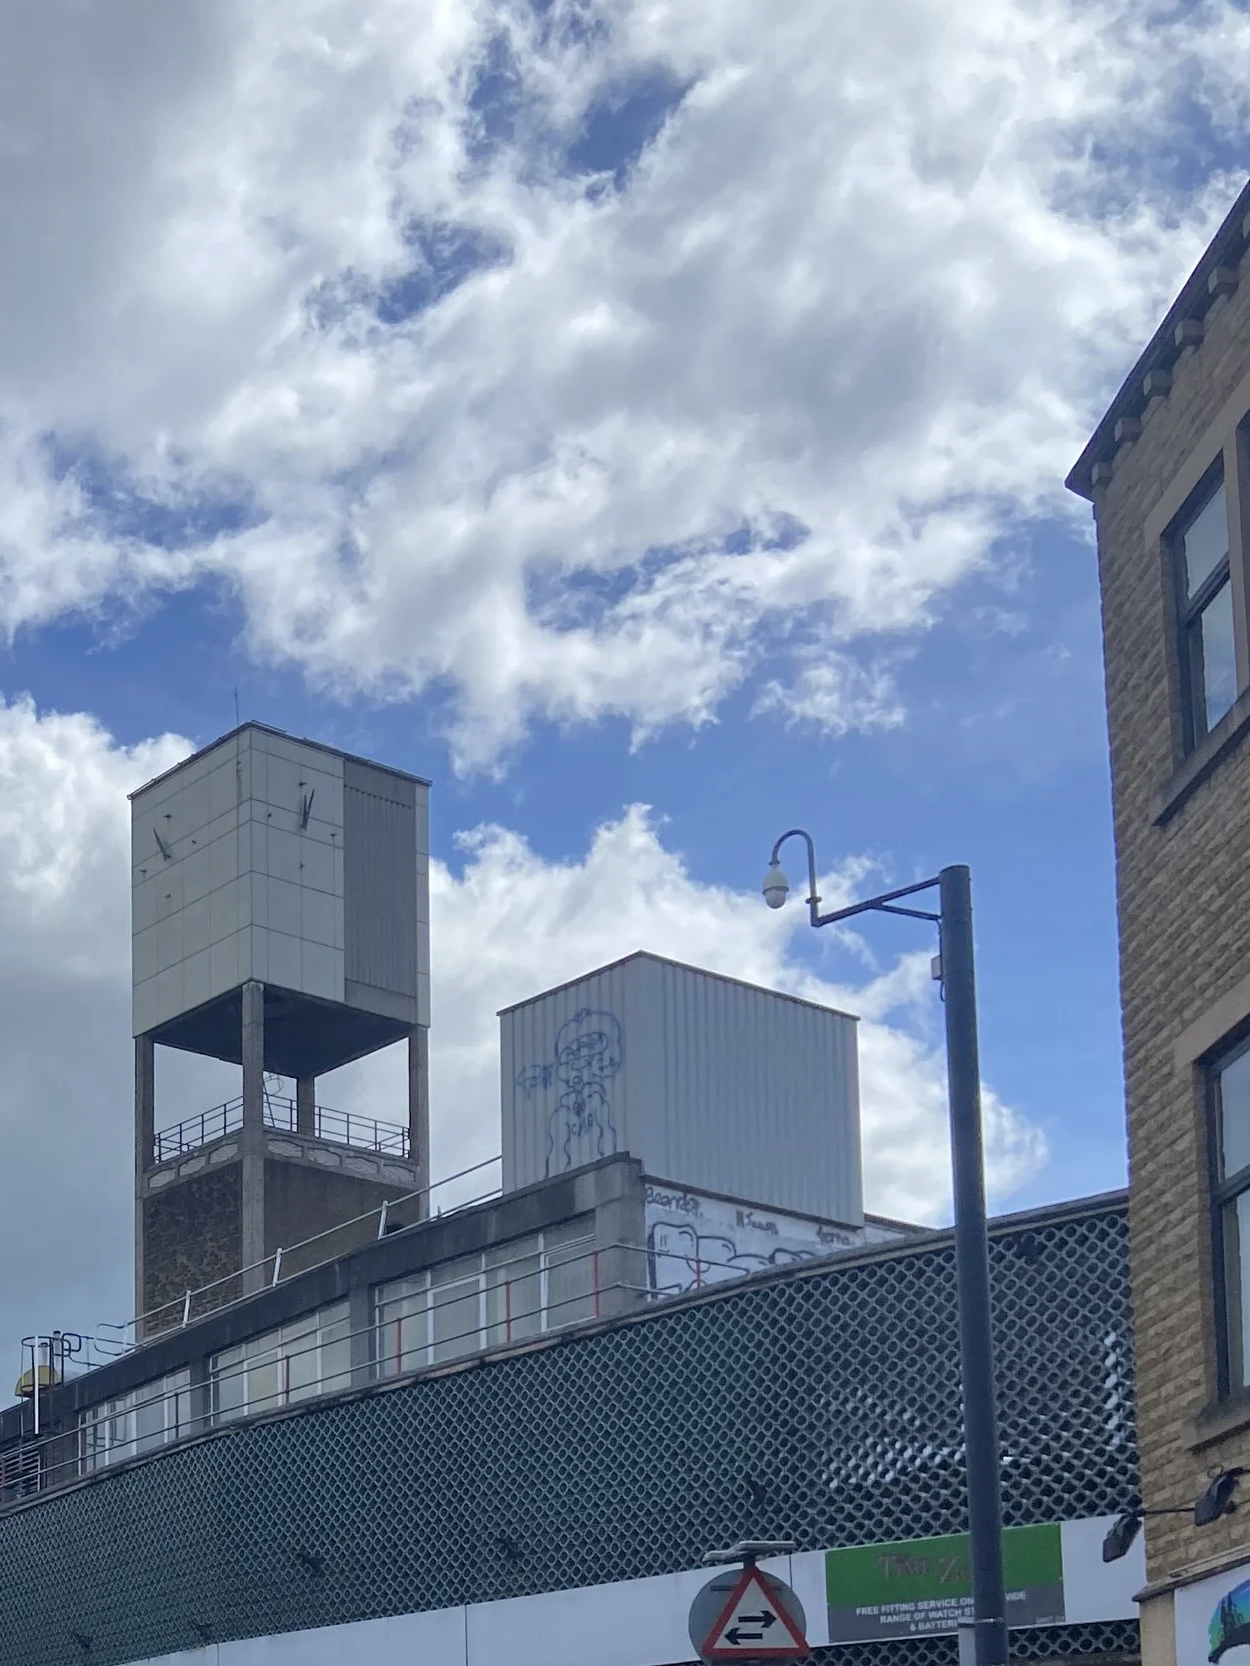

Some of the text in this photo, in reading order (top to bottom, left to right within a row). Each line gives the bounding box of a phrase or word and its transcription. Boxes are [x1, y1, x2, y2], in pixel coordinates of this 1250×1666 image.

[856, 1606, 879, 1617] FREE
[881, 1602, 916, 1614] FITTING
[917, 1598, 958, 1612] SERVICE
[880, 1613, 912, 1624] RANGE
[913, 1611, 926, 1621] OF
[928, 1608, 962, 1619] WATCH
[918, 1619, 958, 1631] BATTERI
